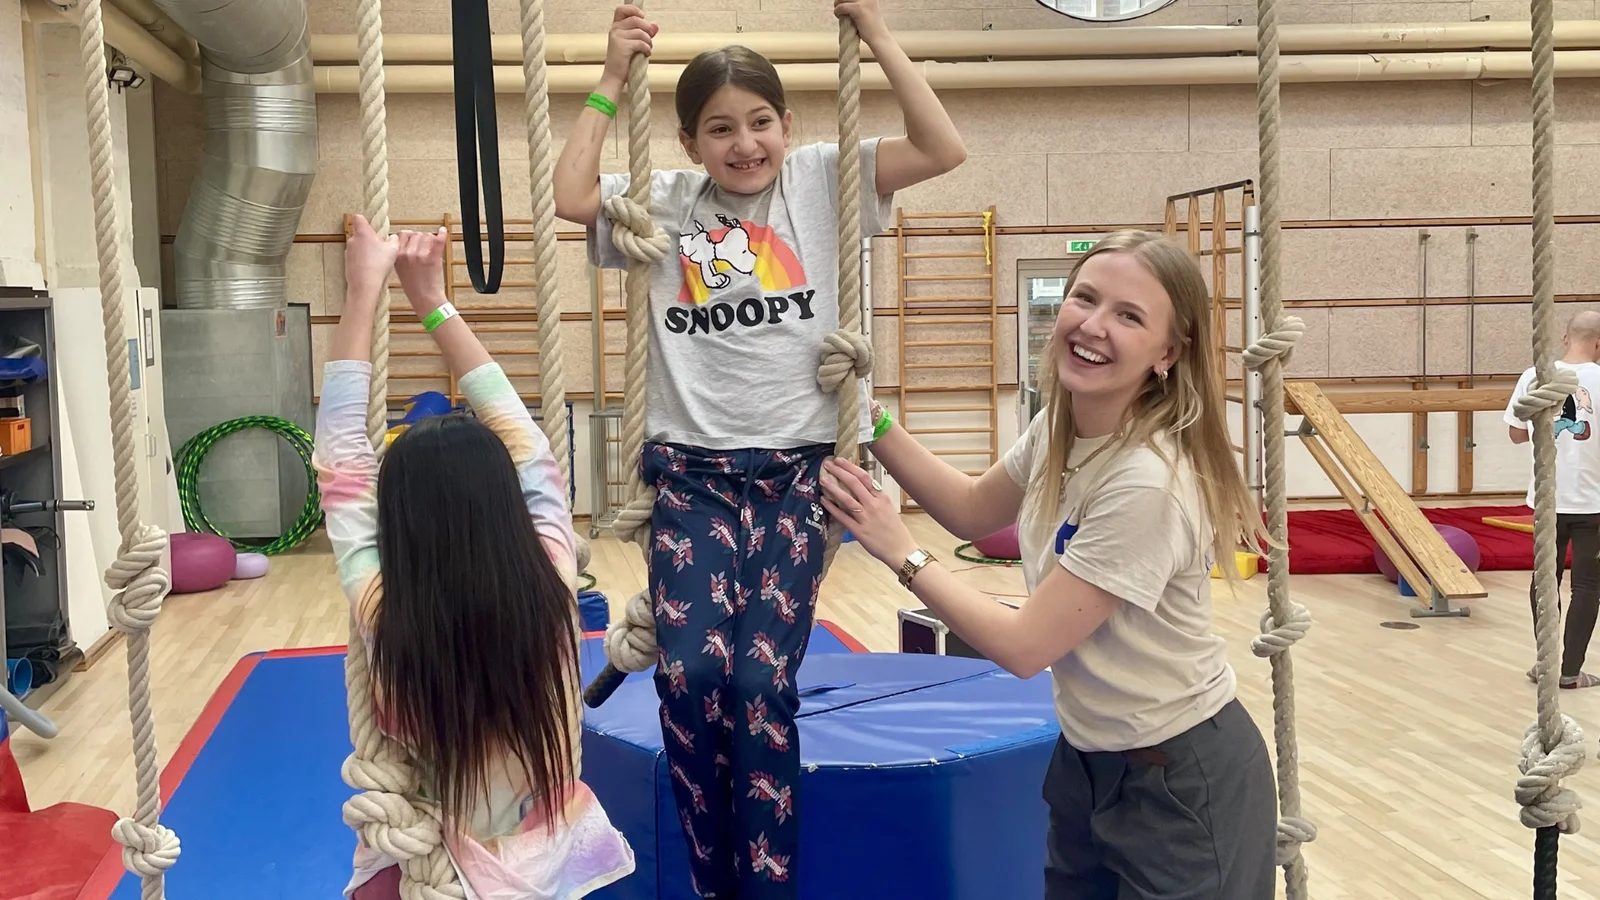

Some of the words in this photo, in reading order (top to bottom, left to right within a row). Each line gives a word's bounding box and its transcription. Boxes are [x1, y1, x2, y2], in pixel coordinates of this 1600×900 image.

[665, 290, 815, 335] SNOOPY
[659, 533, 686, 559] hummel
[779, 517, 802, 552] hummel
[717, 584, 734, 615] humm
[767, 578, 791, 616] hummel
[757, 640, 782, 677] hummel
[754, 710, 785, 746] hummel
[756, 777, 787, 810] hummel
[758, 847, 785, 876] hummel
